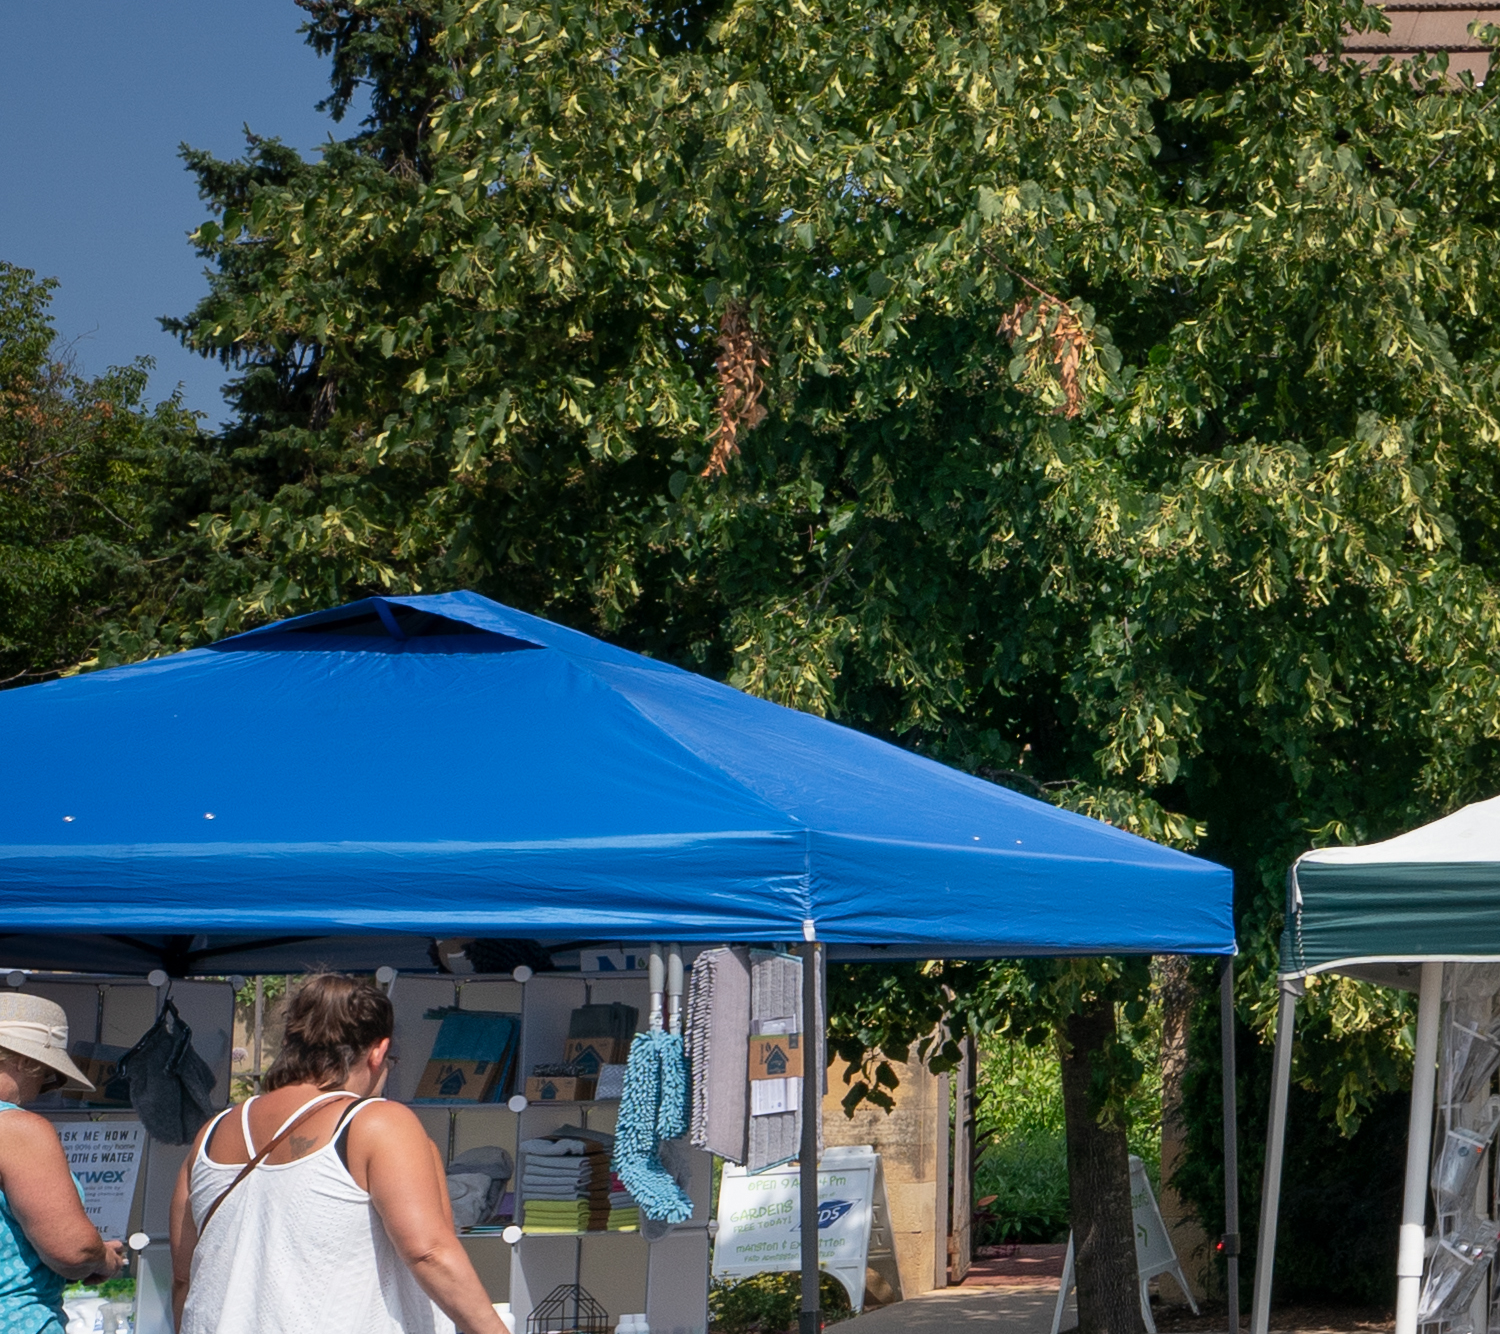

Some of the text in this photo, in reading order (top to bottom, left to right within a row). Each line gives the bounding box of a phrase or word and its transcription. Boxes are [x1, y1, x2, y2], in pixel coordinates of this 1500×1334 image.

[83, 1130, 99, 1142] ME
[104, 1130, 129, 1141] HOW
[133, 1130, 138, 1141] I
[66, 1152, 135, 1164] LOTH & WATER
[72, 1170, 126, 1184] rwex
[818, 1207, 841, 1222] DS
[733, 1215, 793, 1233] FREE TODAY!
